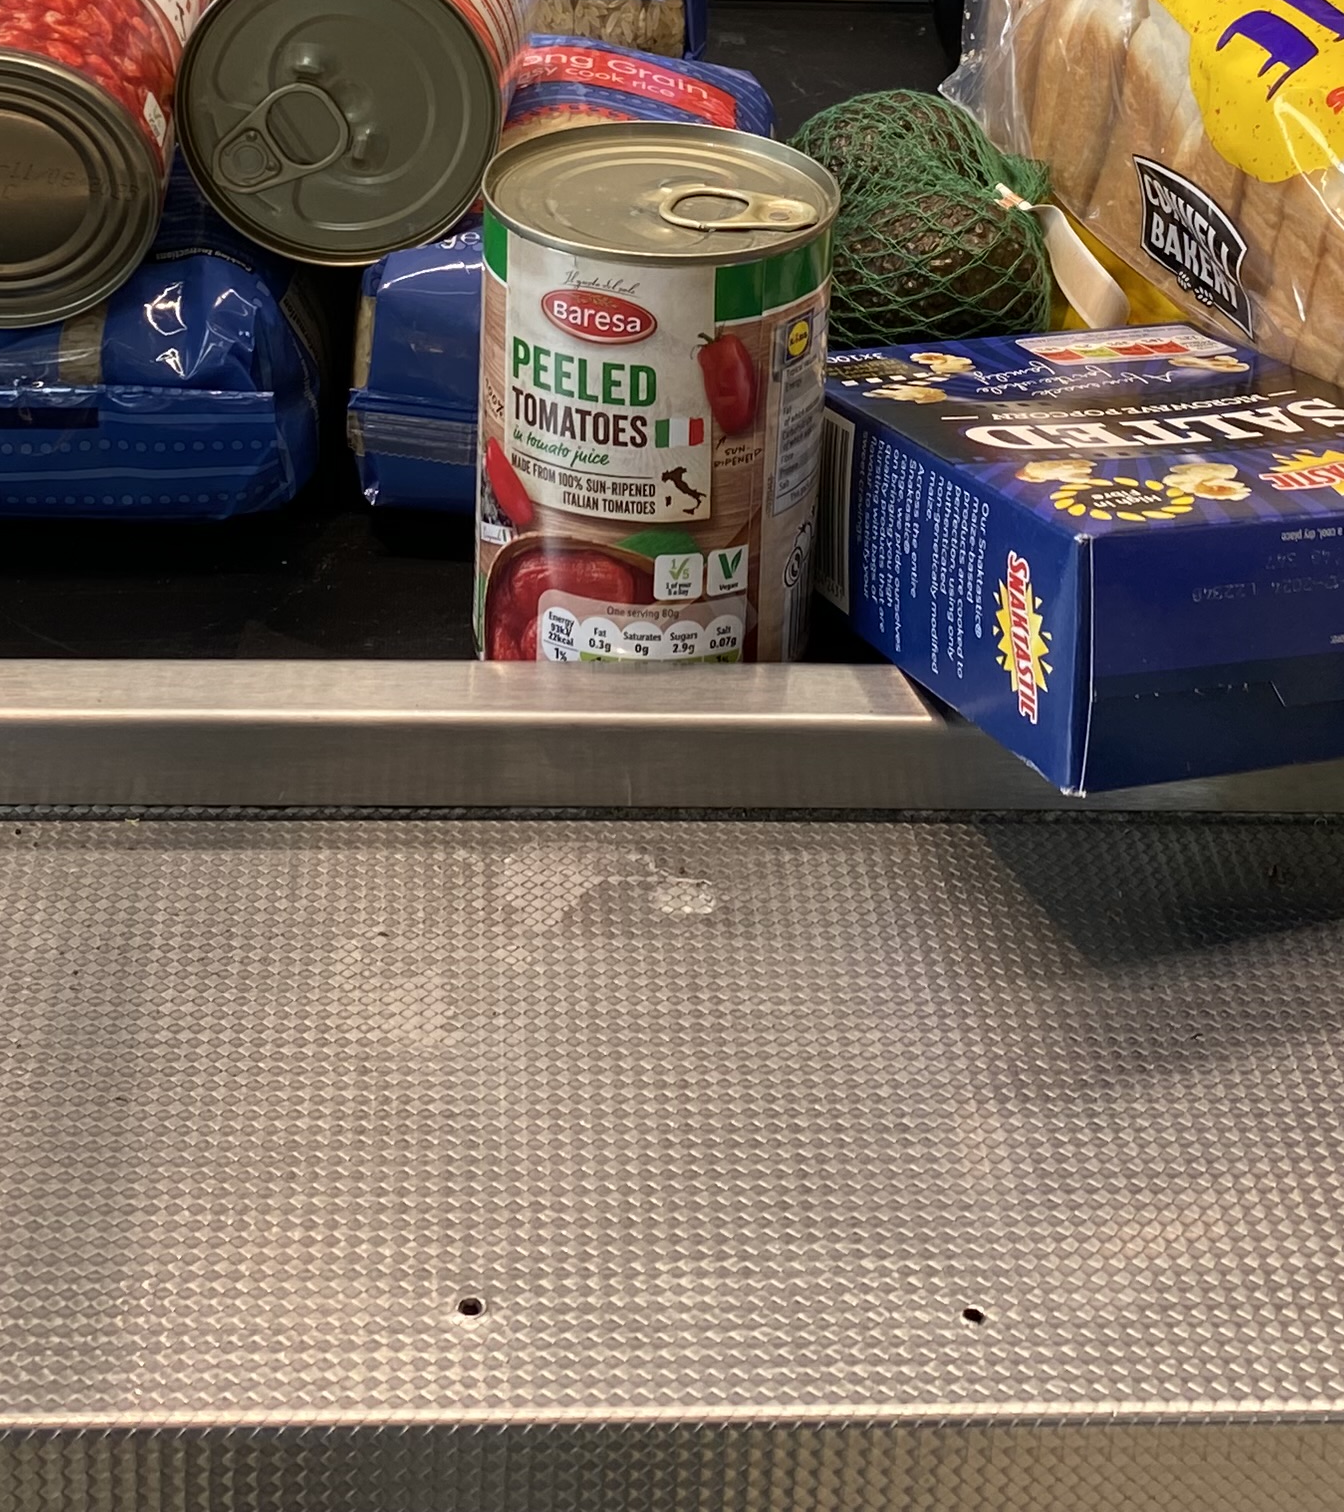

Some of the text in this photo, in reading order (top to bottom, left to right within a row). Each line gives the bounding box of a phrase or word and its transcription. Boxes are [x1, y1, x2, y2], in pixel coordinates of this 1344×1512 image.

[518, 65, 675, 98] asy cook rice
[522, 52, 708, 100] ong Grain
[552, 300, 642, 334] Baresa
[512, 336, 656, 407] PEELED
[991, 392, 1272, 422] MICROWAVE POPCORN
[511, 386, 648, 448] TOMATOES
[513, 427, 610, 468] in tomato juice
[511, 452, 656, 498] MADE FROM 100% SUN-RIPENED
[562, 490, 656, 515] ITALIAN TOMATOES
[1091, 489, 1141, 500] Fibre
[1093, 494, 1162, 508] High in
[980, 502, 990, 534] Our
[959, 490, 970, 565] products
[966, 496, 980, 604] maize-based
[719, 582, 738, 590] Vegan
[548, 611, 575, 627] Energy
[606, 605, 680, 620] One serving 80g
[548, 632, 574, 646] 22kcal
[593, 627, 607, 637] Fat
[623, 631, 662, 642] Saturates
[670, 632, 698, 641] Sugars
[716, 626, 731, 636] Salt
[1007, 550, 1038, 725] SNAKTASTIC
[588, 638, 612, 653] 0.3g
[634, 643, 649, 656] 0g
[672, 643, 695, 654] 2.9g
[709, 636, 737, 649] 0.07g
[554, 648, 567, 661] 1%
[957, 662, 963, 679] to
